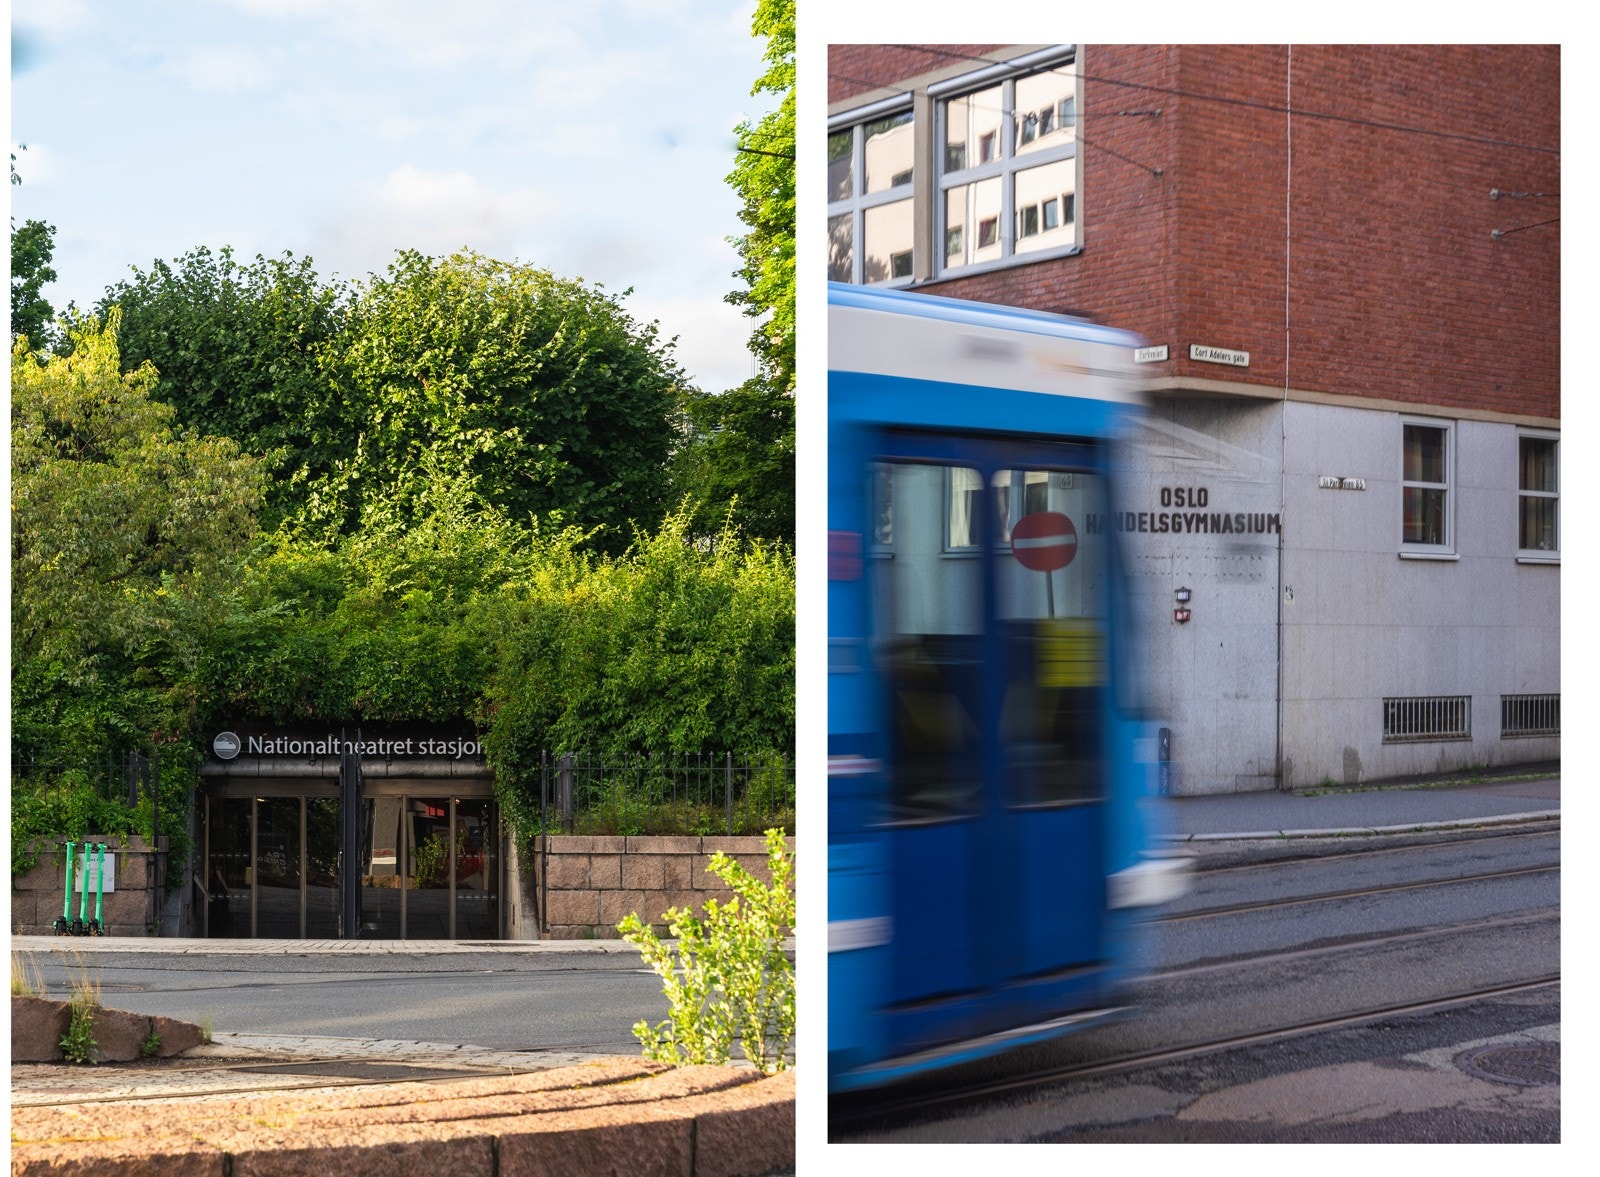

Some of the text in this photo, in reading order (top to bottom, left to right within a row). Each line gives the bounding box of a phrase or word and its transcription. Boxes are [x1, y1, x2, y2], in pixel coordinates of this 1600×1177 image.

[1209, 350, 1231, 361] Adelers
[1233, 354, 1245, 365] gate
[1160, 487, 1208, 508] OSLO
[248, 735, 413, 755] Nationaltheatret
